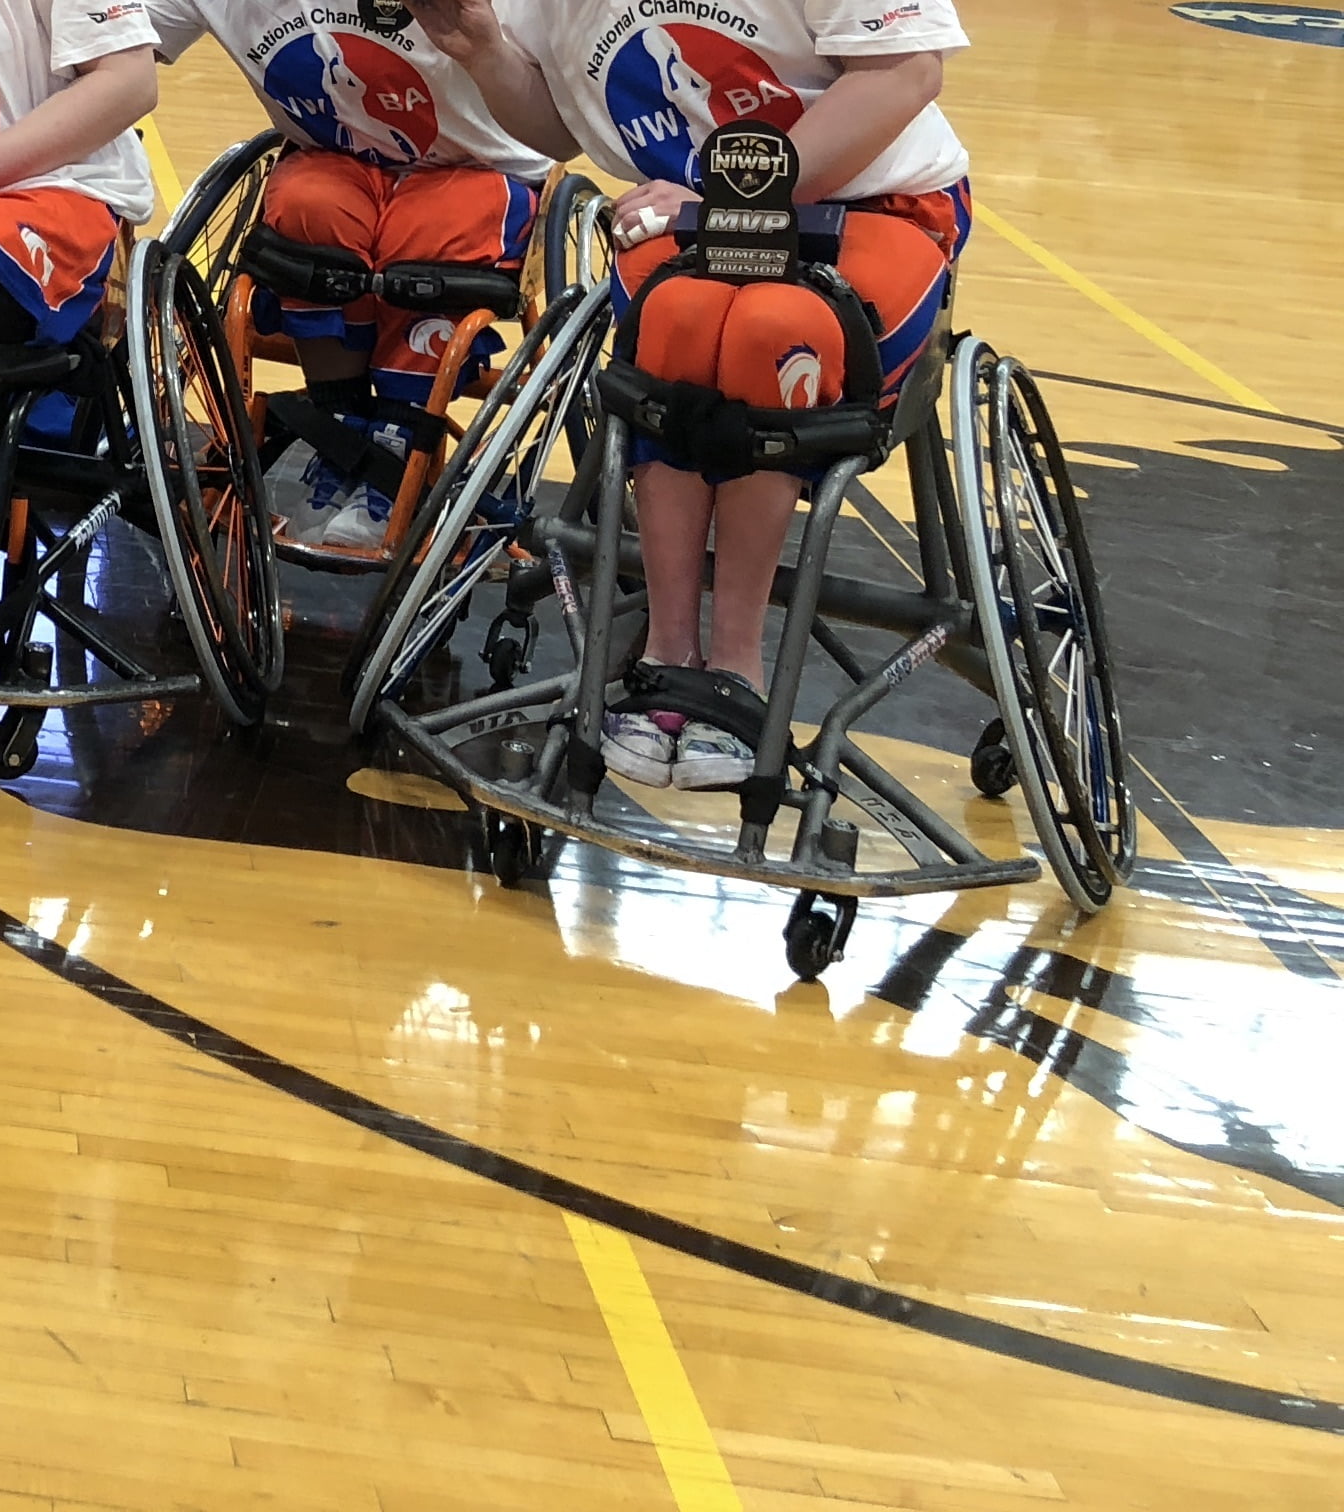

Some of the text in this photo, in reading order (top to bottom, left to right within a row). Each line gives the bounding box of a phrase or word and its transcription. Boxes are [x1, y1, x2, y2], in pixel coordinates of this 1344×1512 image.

[247, 13, 308, 66] National
[587, 6, 637, 82] National
[376, 87, 430, 113] BA
[619, 80, 792, 151] NW BA
[715, 153, 783, 172] NIWBT
[706, 208, 790, 233] MVP
[706, 247, 789, 263] WOMEN'S
[708, 262, 785, 277] DIVISION
[467, 710, 530, 735] UTA
